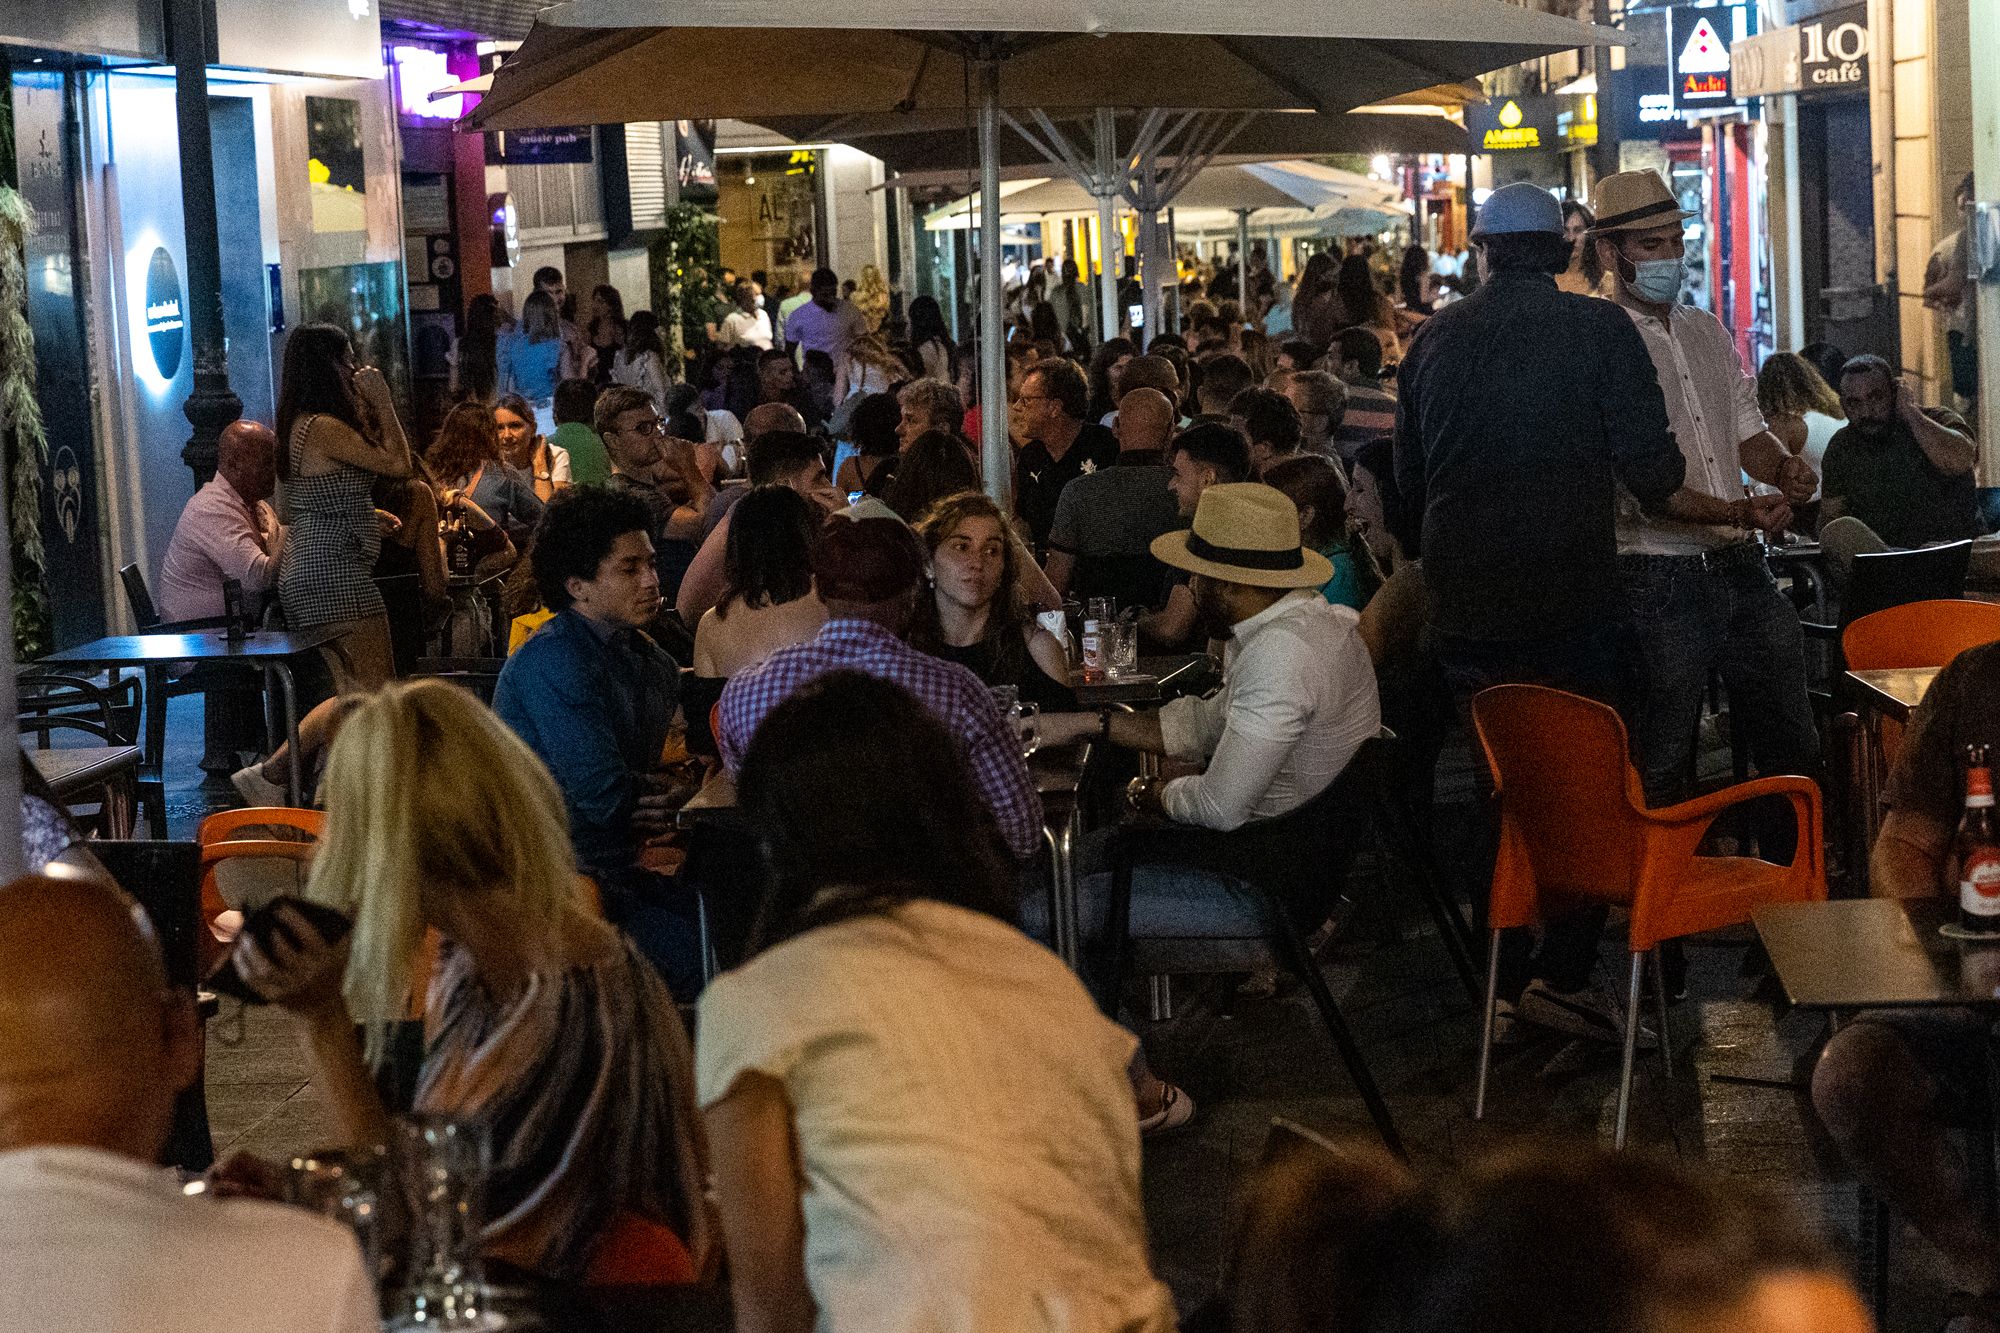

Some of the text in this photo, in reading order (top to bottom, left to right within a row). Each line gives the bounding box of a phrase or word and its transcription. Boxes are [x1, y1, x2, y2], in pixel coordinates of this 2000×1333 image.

[1803, 22, 1869, 64] 10
[1812, 61, 1862, 84] café
[519, 133, 577, 145] music pub
